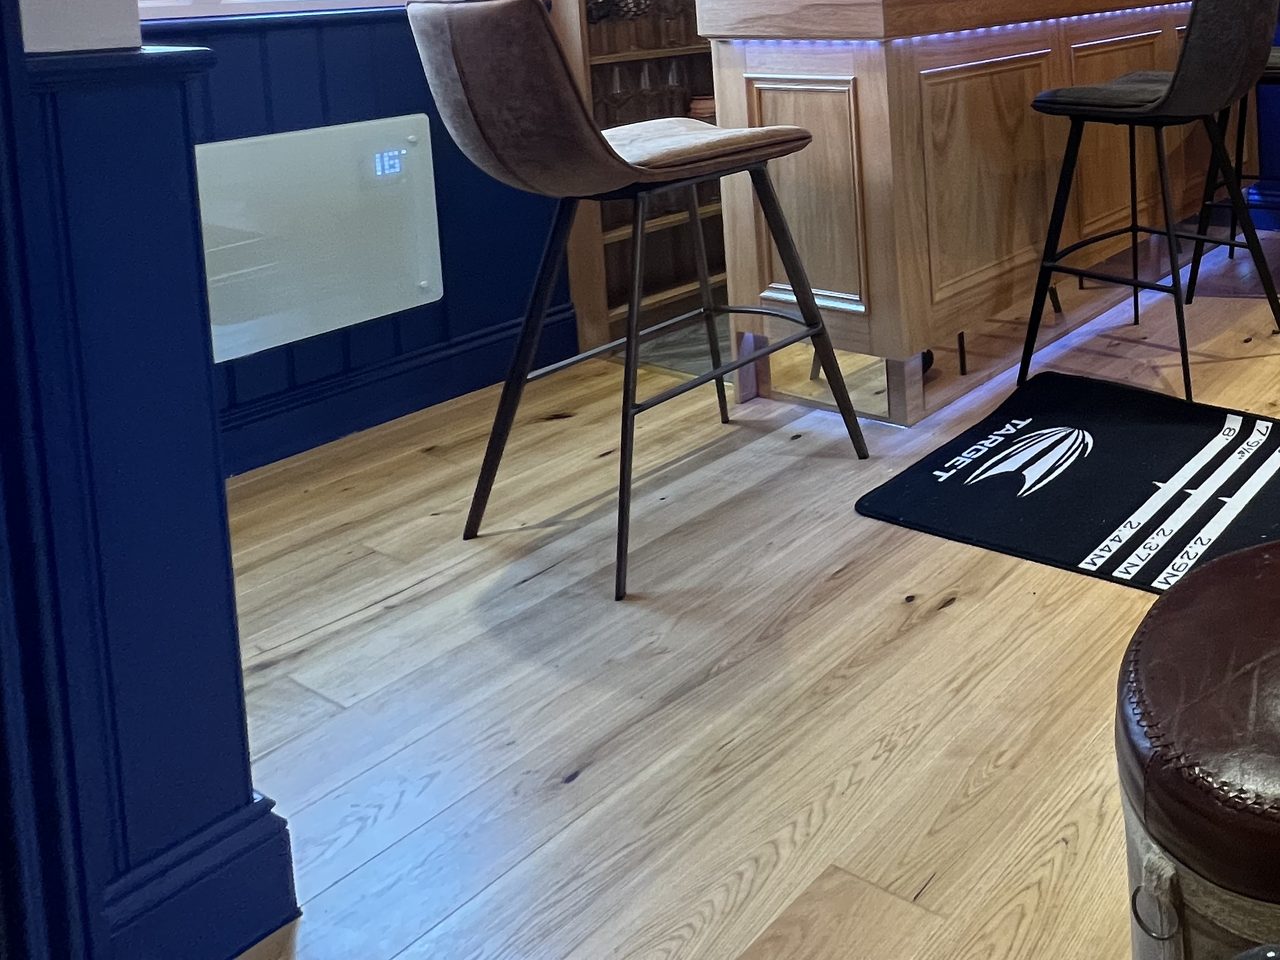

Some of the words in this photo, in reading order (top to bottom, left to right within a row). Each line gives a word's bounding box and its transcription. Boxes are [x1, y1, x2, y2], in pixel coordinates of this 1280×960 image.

[933, 418, 1032, 482] TARGET
[1084, 520, 1141, 567] 2.44M
[1118, 528, 1174, 575] 2.37M
[1158, 536, 1211, 585] 2.29M
